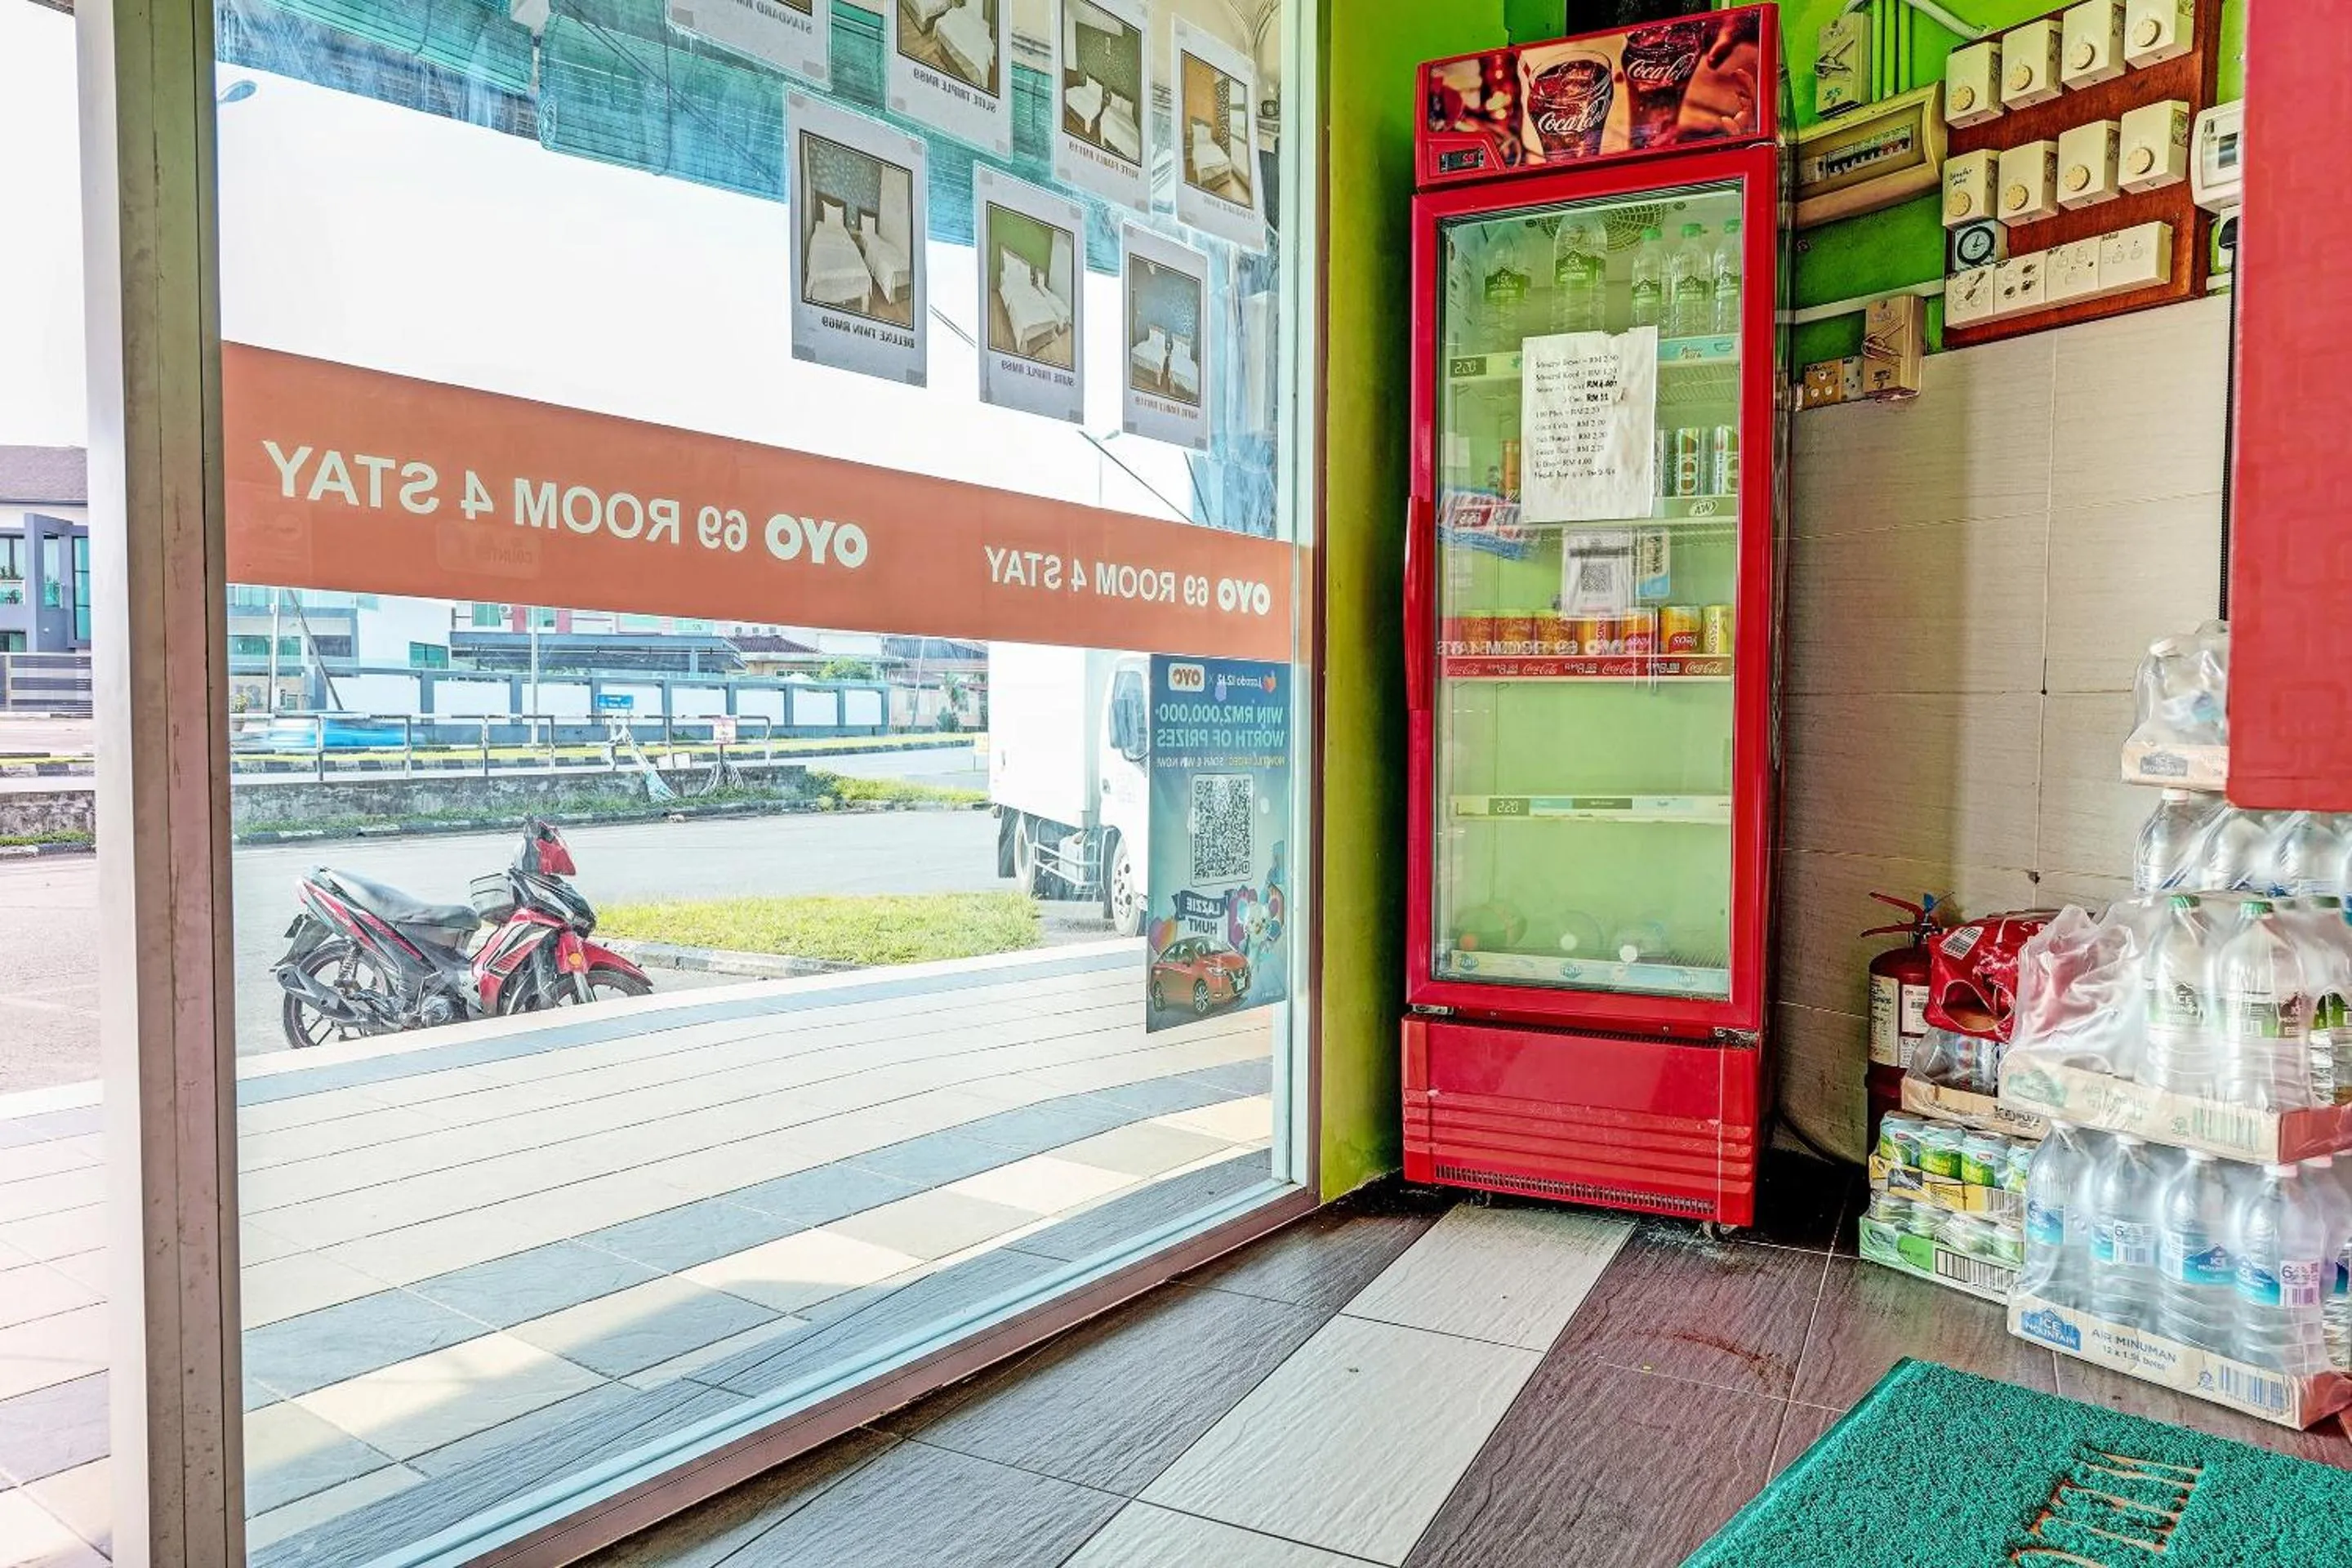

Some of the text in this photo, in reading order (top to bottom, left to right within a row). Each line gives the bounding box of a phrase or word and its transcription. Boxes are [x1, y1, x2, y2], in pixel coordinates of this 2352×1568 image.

[2025, 1321, 2081, 1350] MOUNTAIN
[2039, 1314, 2065, 1332] ICE
[2091, 1328, 2176, 1363] AIR MINUMAN
